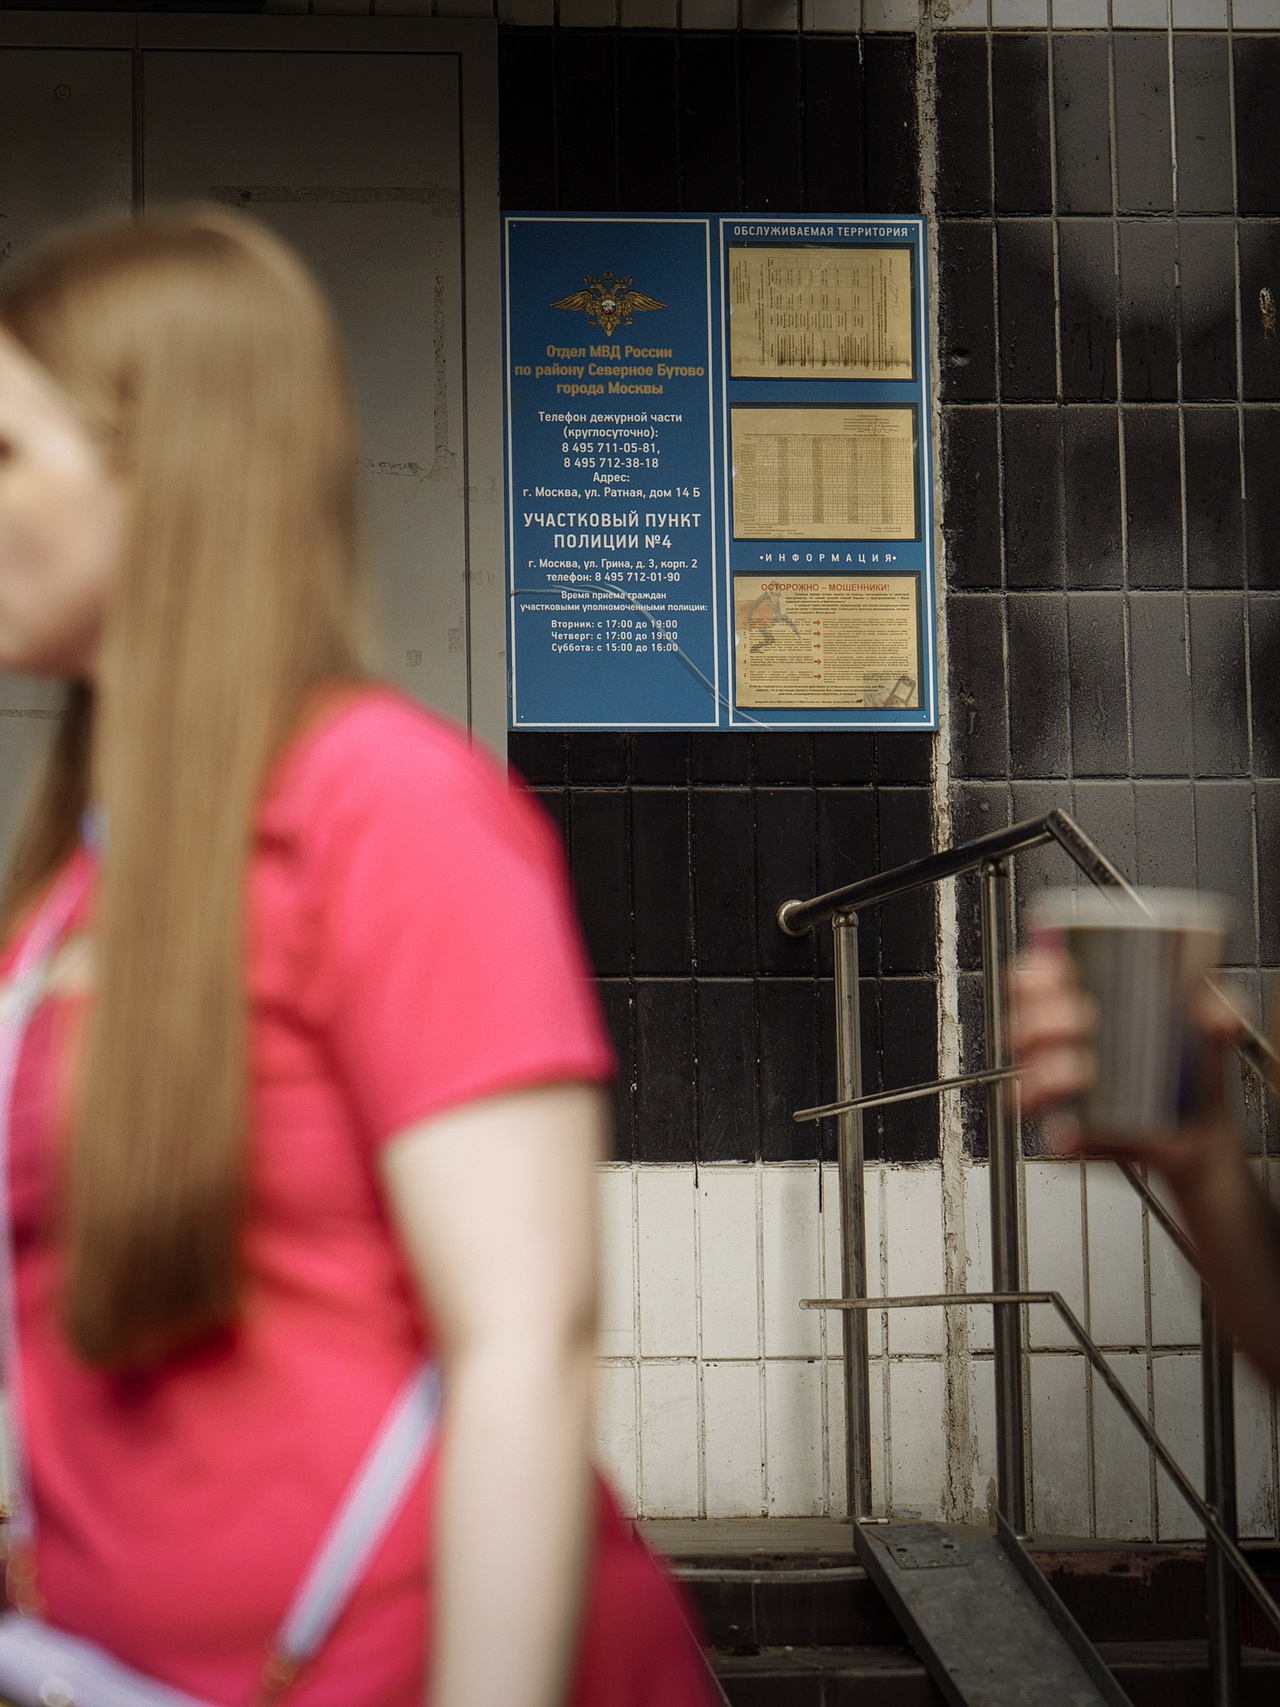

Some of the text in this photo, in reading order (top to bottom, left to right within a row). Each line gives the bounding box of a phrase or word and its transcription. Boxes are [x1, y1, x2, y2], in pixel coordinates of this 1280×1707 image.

[734, 226, 908, 237] ОБСЛУЖИВАЕМАЯ ТЕРРИТОРИЯ
[546, 345, 672, 360] Отдел МВД России
[515, 363, 704, 378] по району Северное Бутово
[557, 382, 663, 396] города Москвы
[538, 412, 682, 424] Телефон дежурной части
[563, 426, 658, 439] (круглосуточно):
[562, 443, 660, 454] 8 495 711-05-81,
[564, 458, 658, 468] 8 495 712-38-18
[593, 473, 629, 484] Адрес:
[523, 487, 700, 500] г. Москва, ул. Ратная, дом 14 Б
[523, 510, 701, 527] УЧАСТКОВЫЙ ПУНКТ
[554, 534, 672, 551] ПОЛИЦИИ №4
[529, 559, 697, 571] г. Москва, ул. Грина, д. 3, корп. 2
[547, 572, 680, 584] телефон: 8 495 712-01-90
[761, 583, 819, 591] ОСТОРОЖНО
[562, 591, 666, 601] Время приема граждан
[520, 604, 579, 613] участковыми
[582, 605, 665, 613] уполномоченными
[552, 620, 594, 630] Вторник:
[606, 620, 632, 628] 17:00
[636, 621, 647, 629] до
[651, 620, 677, 628] 19:00
[552, 632, 593, 642] Четверг:
[605, 632, 632, 640] 17:00
[636, 633, 647, 641] до
[651, 632, 678, 640] 19:00
[552, 644, 593, 653] Суббота:
[606, 644, 632, 652] 15:00
[636, 645, 647, 653] до
[651, 644, 678, 652] 16:00
